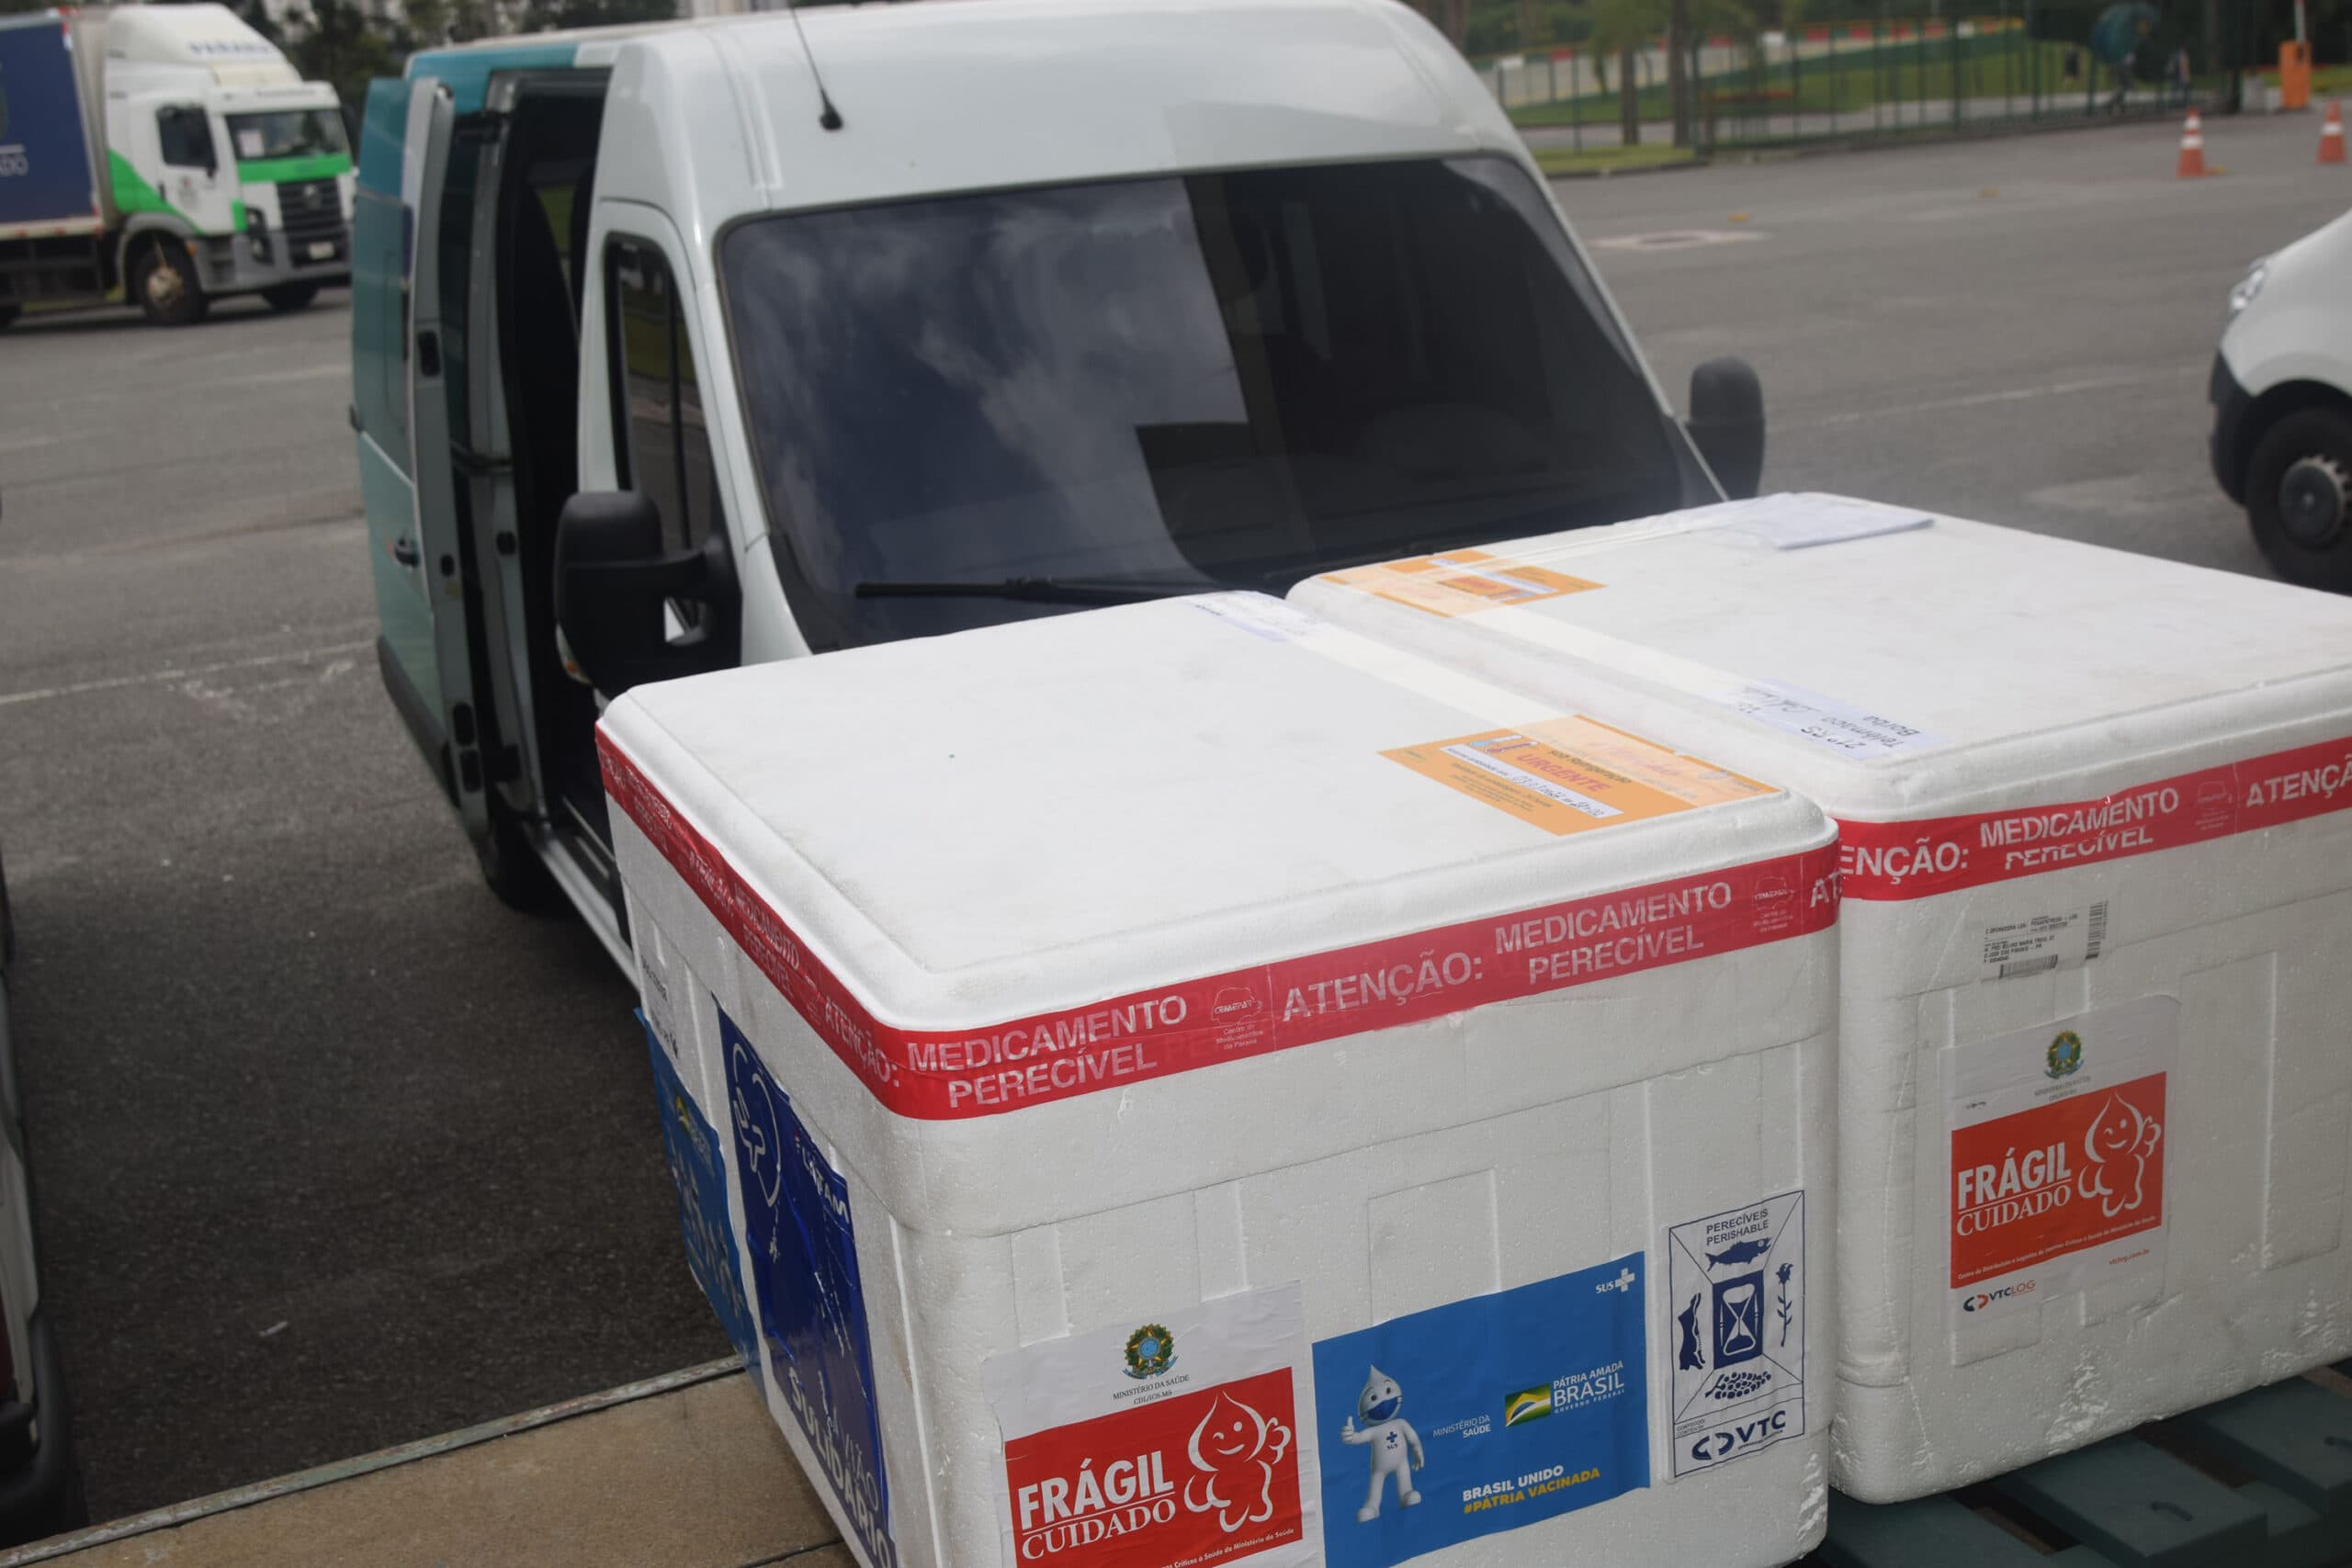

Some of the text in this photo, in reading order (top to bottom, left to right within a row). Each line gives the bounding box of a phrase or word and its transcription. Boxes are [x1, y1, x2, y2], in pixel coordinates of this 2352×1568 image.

[1518, 753, 1611, 792] URGENTE
[1980, 786, 2179, 848] MEDICAMENTO
[1494, 881, 1733, 955] MEDICAMENTO
[1528, 924, 1705, 986] PERECÍVEL
[1282, 948, 1485, 1023] ATENÇÃO:
[825, 996, 900, 1088] ATENÇÃO:
[907, 995, 1188, 1072] MEDICAMENTO
[947, 1043, 1159, 1109] PERECÍVEL
[1958, 1142, 2072, 1210] FRÁGIL
[1706, 1208, 1769, 1235] PERECÍVEIS
[1957, 1185, 2071, 1236] CUIDADO
[1706, 1219, 1769, 1246] PERISHABLE
[1595, 1280, 1615, 1294] SUS
[1989, 1279, 2037, 1302] VTCLOG
[1113, 1374, 1191, 1400] MINISTÉRIO DA SAÚDE
[1553, 1359, 1623, 1390] PÁTRIA AMADA
[1554, 1372, 1625, 1407] BRASIL
[1432, 1414, 1491, 1438] MINISTÉRIO DA
[1462, 1423, 1491, 1438] SAÚDE
[1736, 1410, 1786, 1443] VTC
[1018, 1450, 1174, 1530] FRÁGIL
[1463, 1465, 1565, 1502] BRASIL UNIDO
[1464, 1467, 1600, 1514] #PÁTRIA VACINADA
[1022, 1498, 1176, 1560] CUIDADO
